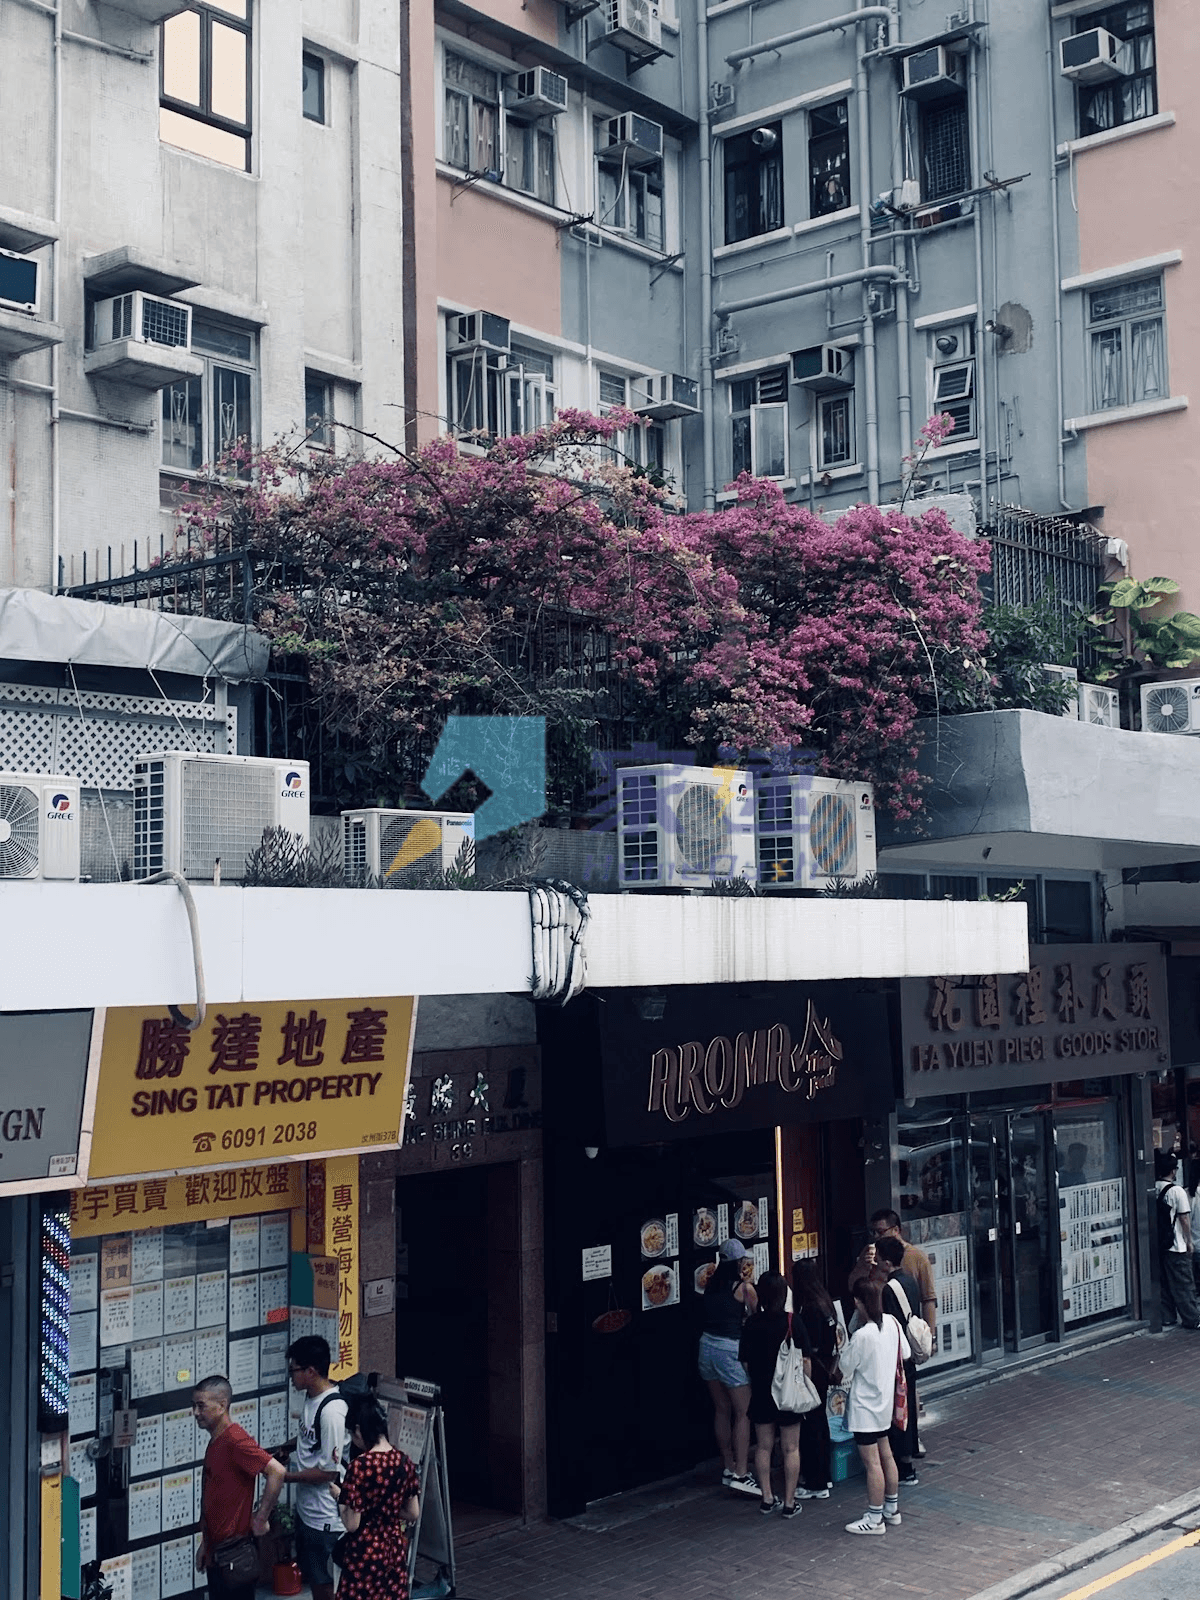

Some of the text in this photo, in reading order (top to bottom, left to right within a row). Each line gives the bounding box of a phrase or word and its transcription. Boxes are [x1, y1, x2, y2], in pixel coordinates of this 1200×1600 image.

[281, 790, 305, 799] GREE
[47, 811, 74, 821] GREE
[135, 1007, 389, 1080] 勝達地產
[916, 1045, 940, 1071] FA
[948, 1040, 994, 1068] YUEN
[1060, 1031, 1112, 1058] GOODS
[648, 1022, 802, 1122] AROMA
[131, 1072, 383, 1117] SING TAT PROPERTY
[0, 1107, 46, 1142] GN
[221, 1120, 317, 1150] 6091 2038
[185, 1164, 290, 1206] 歡迎放盤
[408, 1381, 420, 1392] 6091
